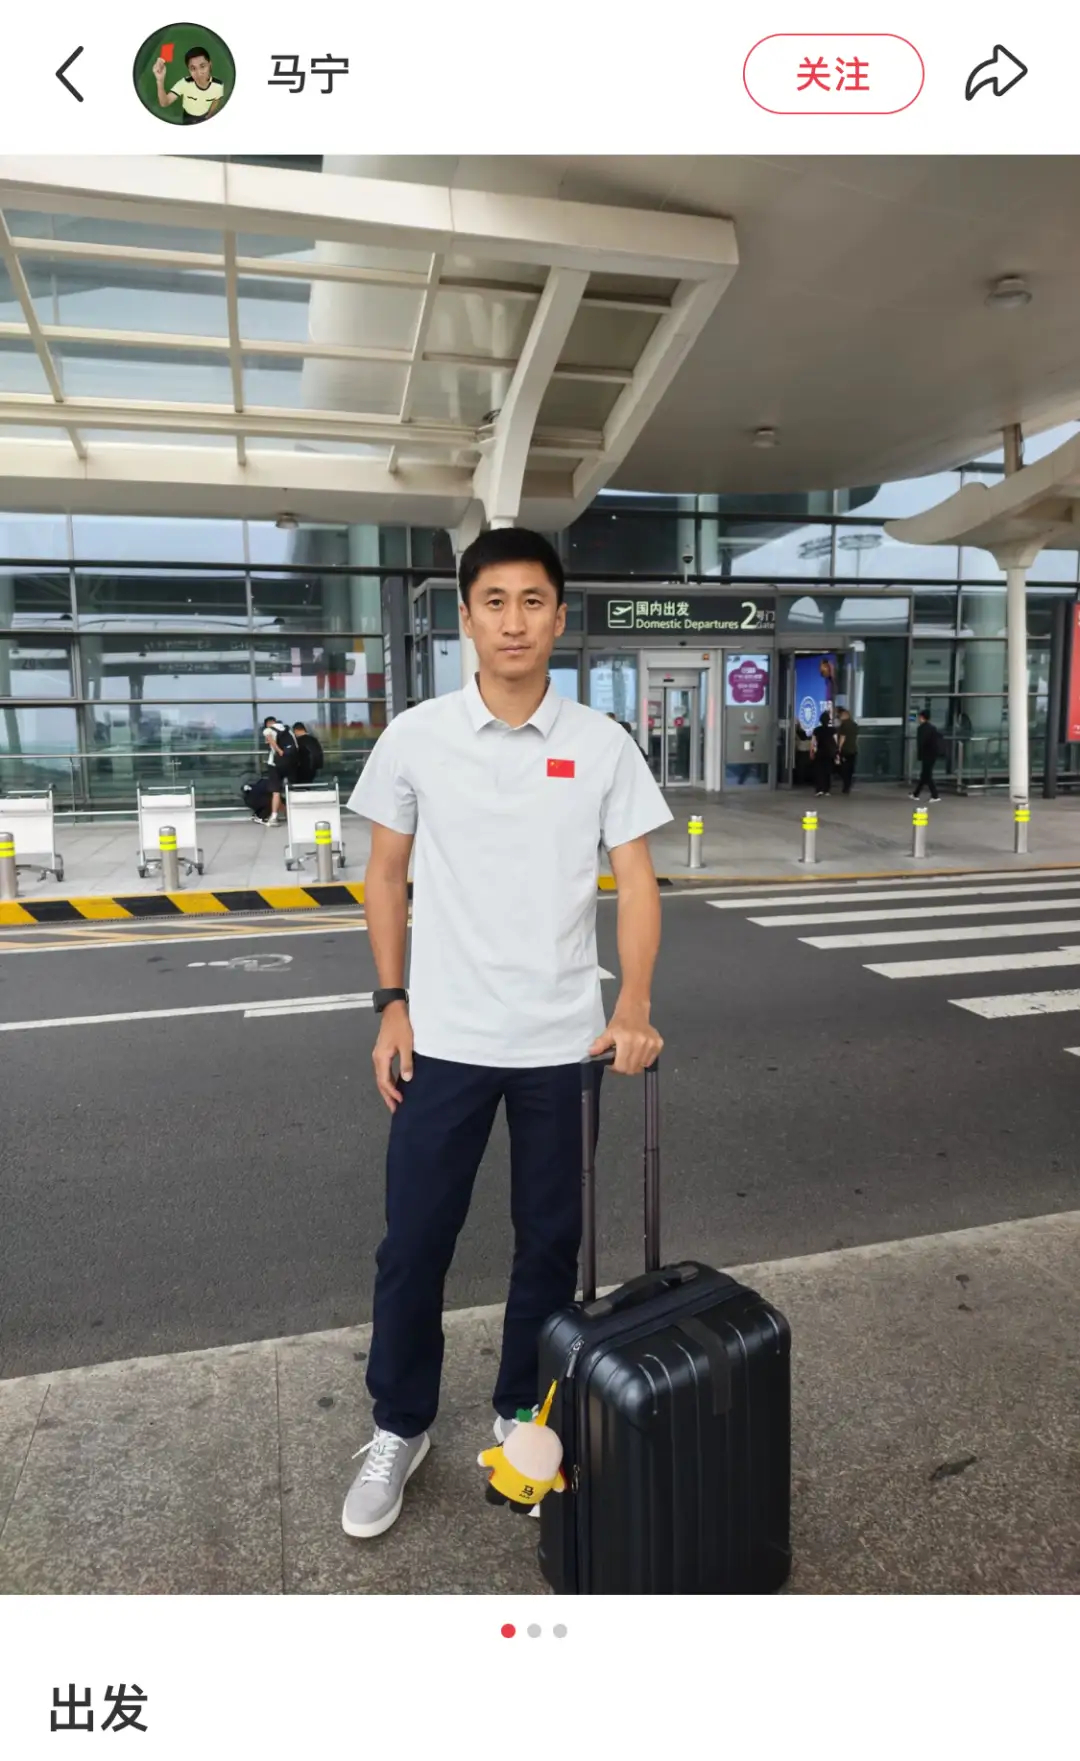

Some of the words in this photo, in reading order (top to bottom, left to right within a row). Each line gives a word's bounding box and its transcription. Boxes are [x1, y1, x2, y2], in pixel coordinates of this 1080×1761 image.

[636, 601, 690, 616] 国内出发
[636, 619, 682, 629] Domestic
[684, 619, 739, 631] Departures
[521, 1484, 534, 1497] 马
